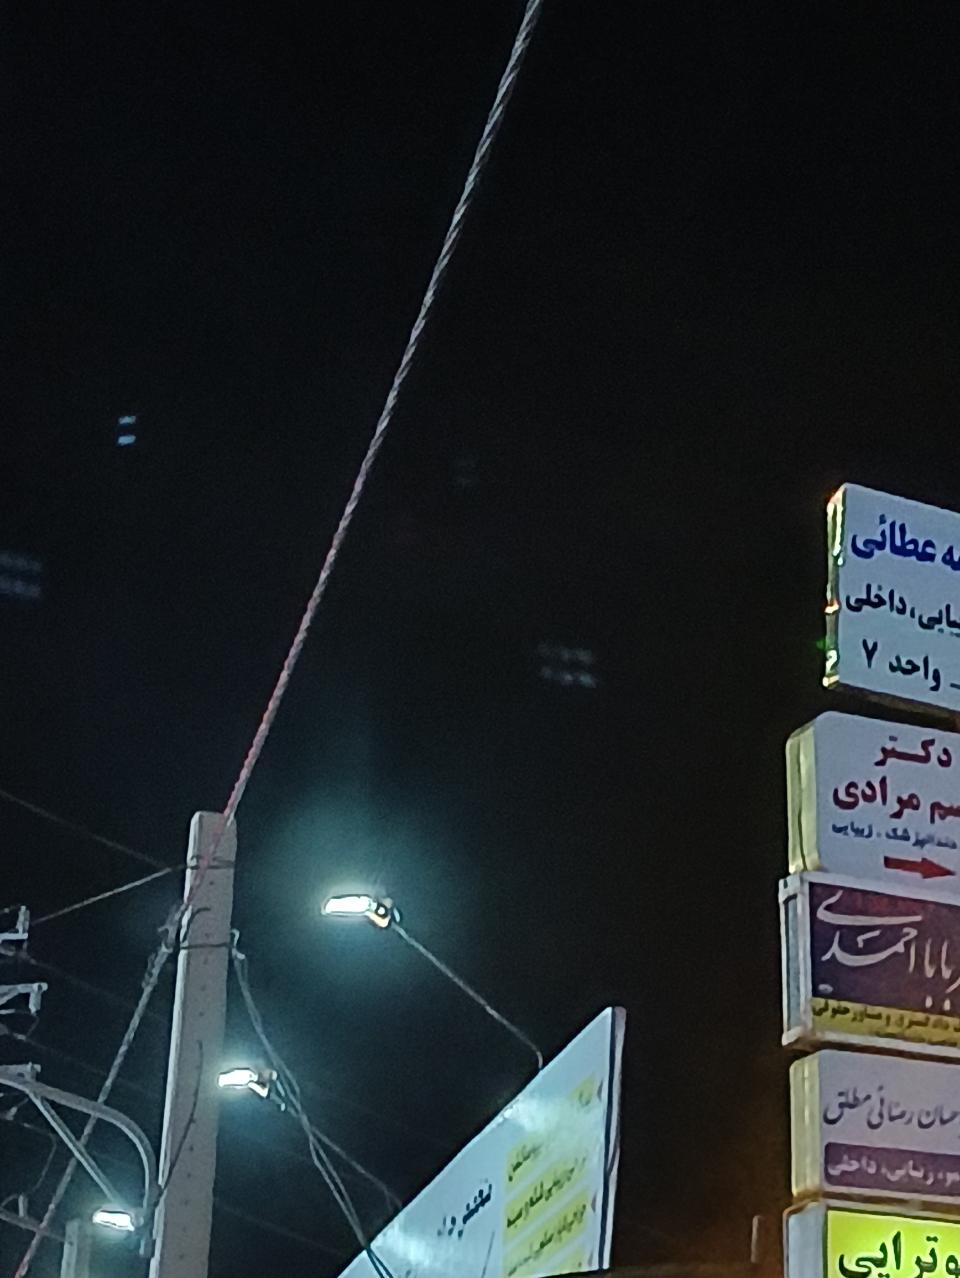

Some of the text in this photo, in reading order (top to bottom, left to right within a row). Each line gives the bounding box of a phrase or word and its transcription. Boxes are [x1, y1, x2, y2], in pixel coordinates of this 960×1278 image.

[845, 583, 906, 615] داخلی
[862, 638, 878, 669] ۷
[889, 655, 941, 691] واحد
[874, 735, 952, 767] دکتر
[832, 776, 921, 819] مرادی
